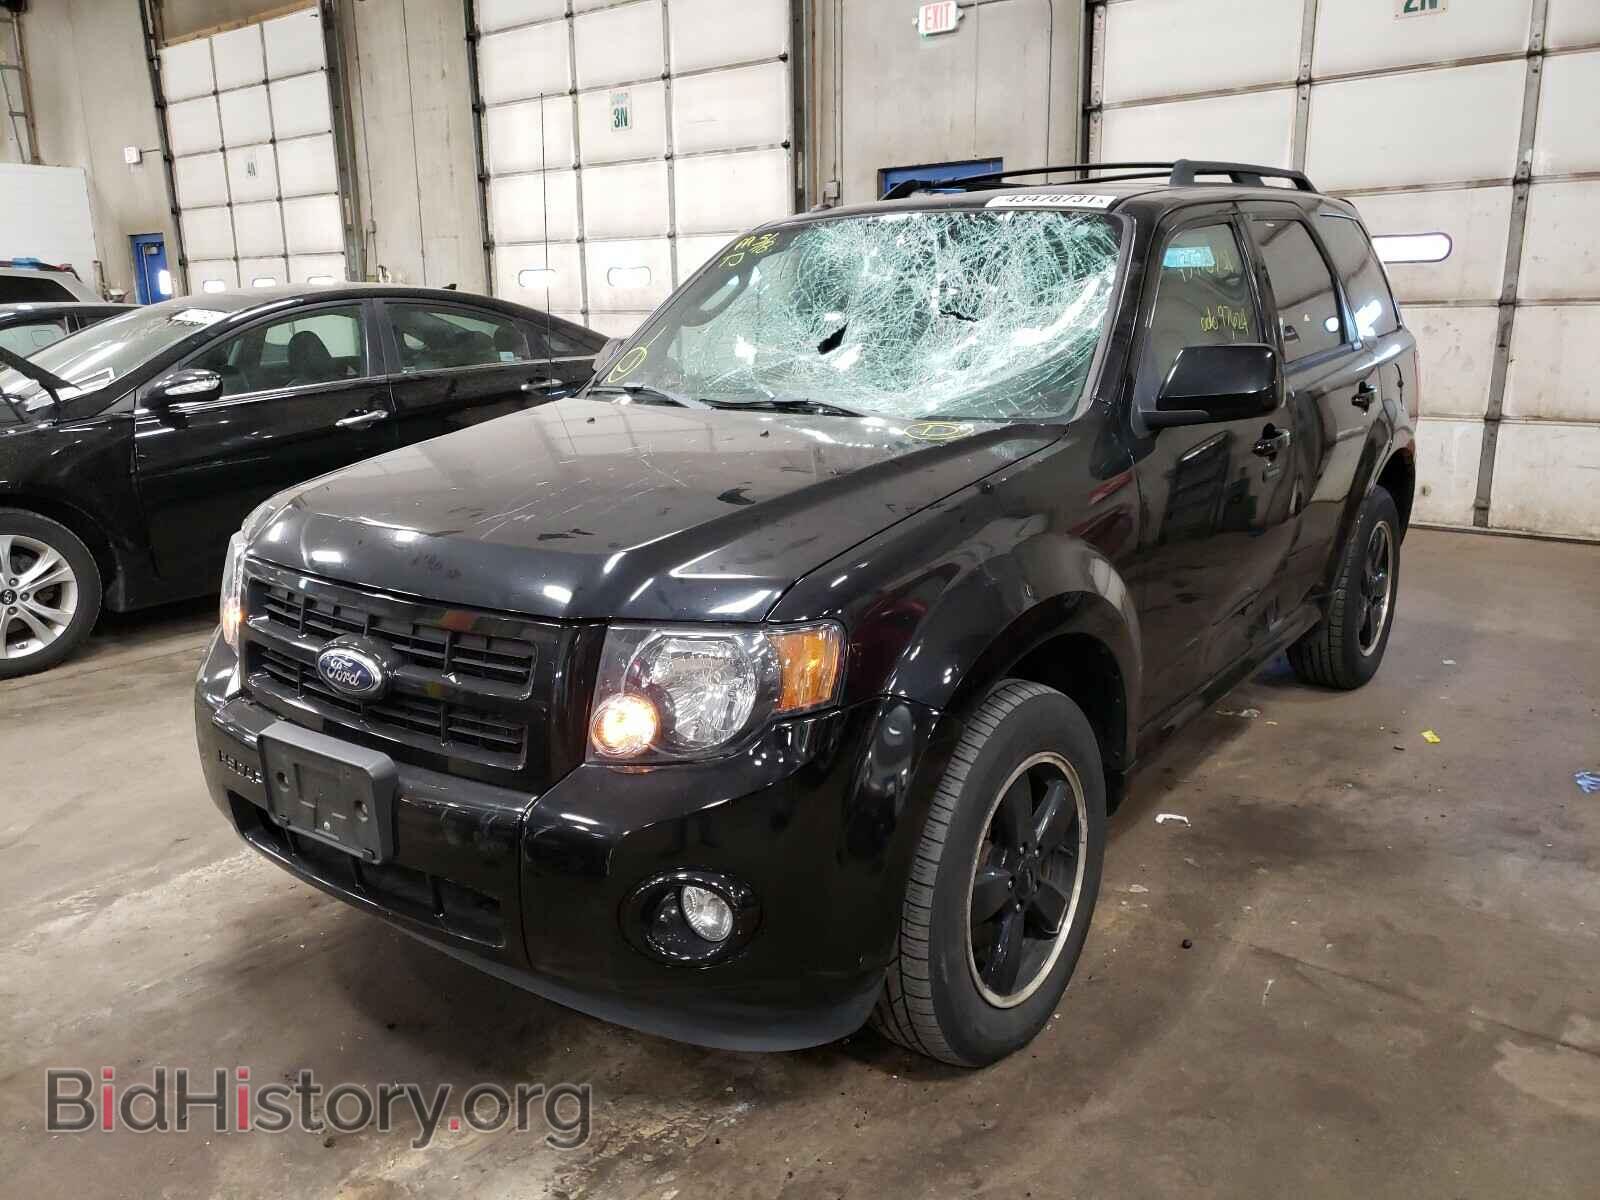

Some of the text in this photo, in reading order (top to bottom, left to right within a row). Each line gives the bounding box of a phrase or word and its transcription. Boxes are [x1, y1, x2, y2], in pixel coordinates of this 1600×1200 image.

[924, 3, 952, 31] EXIT
[614, 107, 628, 128] 3N
[327, 656, 362, 687] Ford
